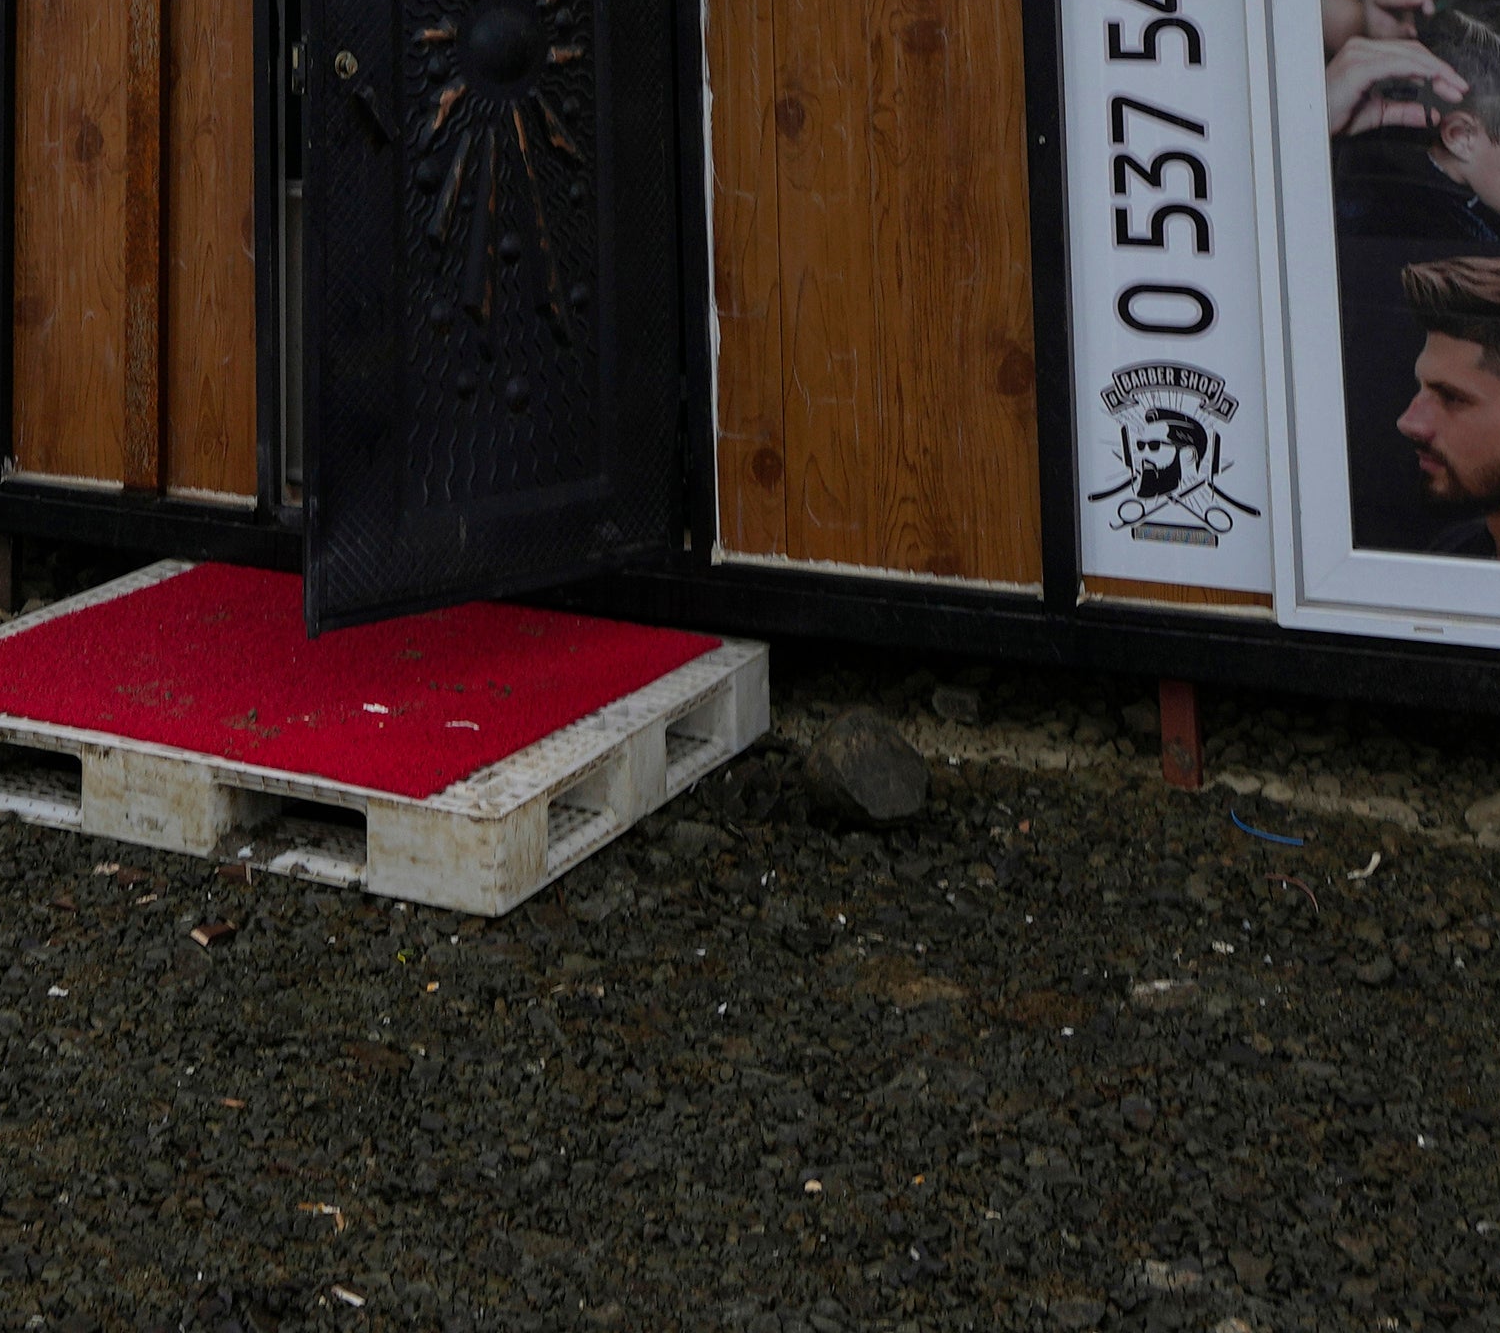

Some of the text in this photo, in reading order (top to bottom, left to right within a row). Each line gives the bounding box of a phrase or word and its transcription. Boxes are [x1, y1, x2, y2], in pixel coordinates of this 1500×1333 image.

[1110, 96, 1211, 254] 537
[1117, 284, 1215, 333] 0
[1120, 366, 1219, 396] BARBER SHOP
